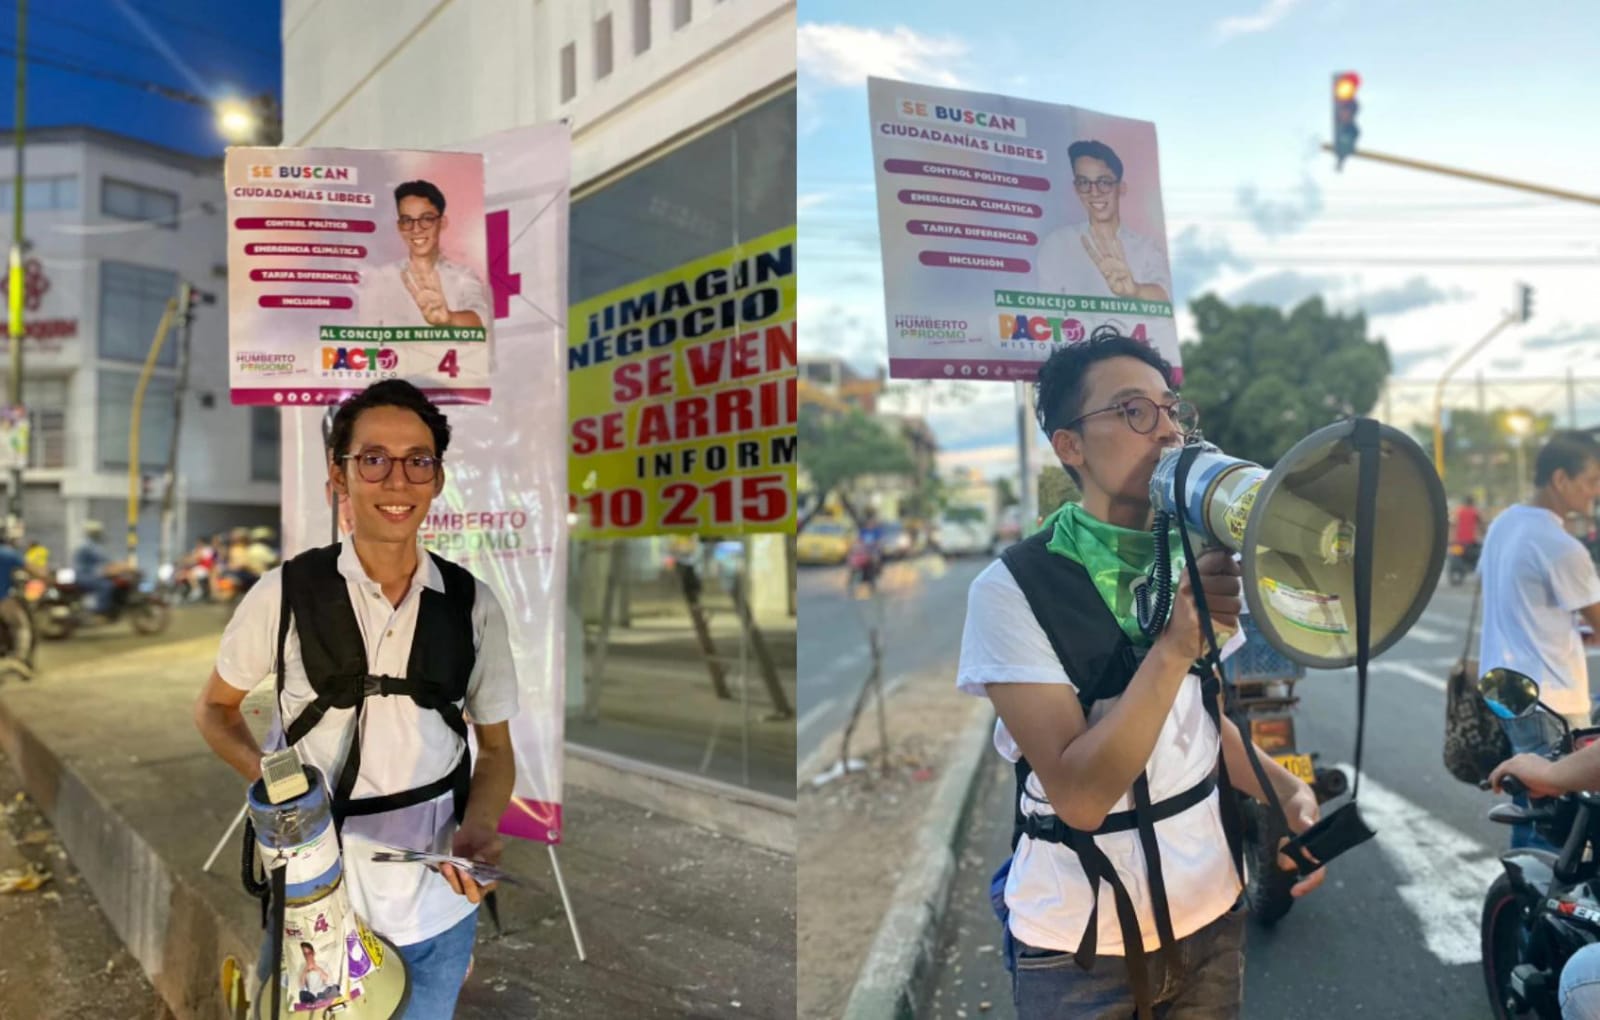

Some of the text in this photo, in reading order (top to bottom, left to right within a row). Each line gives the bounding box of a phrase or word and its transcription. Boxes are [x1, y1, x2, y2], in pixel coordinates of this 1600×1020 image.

[902, 101, 1016, 132] SE BUSCAN
[880, 123, 1044, 161] CIUDADANÍAS LIBRES
[252, 166, 349, 180] SE BUSCAN
[922, 164, 1019, 185] CONTROL POLÍTICO
[327, 191, 372, 205] LIBRES
[910, 192, 978, 208] EMERGENCIA
[264, 219, 306, 228] CONTROL
[922, 223, 1029, 242] TARIFA DIFERENCIAL
[253, 245, 310, 254] EMERGENCIA
[948, 254, 1005, 269] INCLUSIÓN
[261, 271, 296, 279] TARIFA
[996, 293, 1173, 316] AL CONCEJO DE NEIVA VOTA
[568, 287, 780, 370] NEGOCIO
[895, 319, 968, 330] HUMBERTO
[321, 329, 484, 341] AL CONCEJO DE NEIVA VOTA
[321, 347, 398, 370] PACTO
[438, 349, 460, 378] 4
[612, 354, 674, 404] SE
[571, 411, 625, 456] SE
[661, 474, 788, 525] 215
[418, 511, 527, 531] UMBERTO
